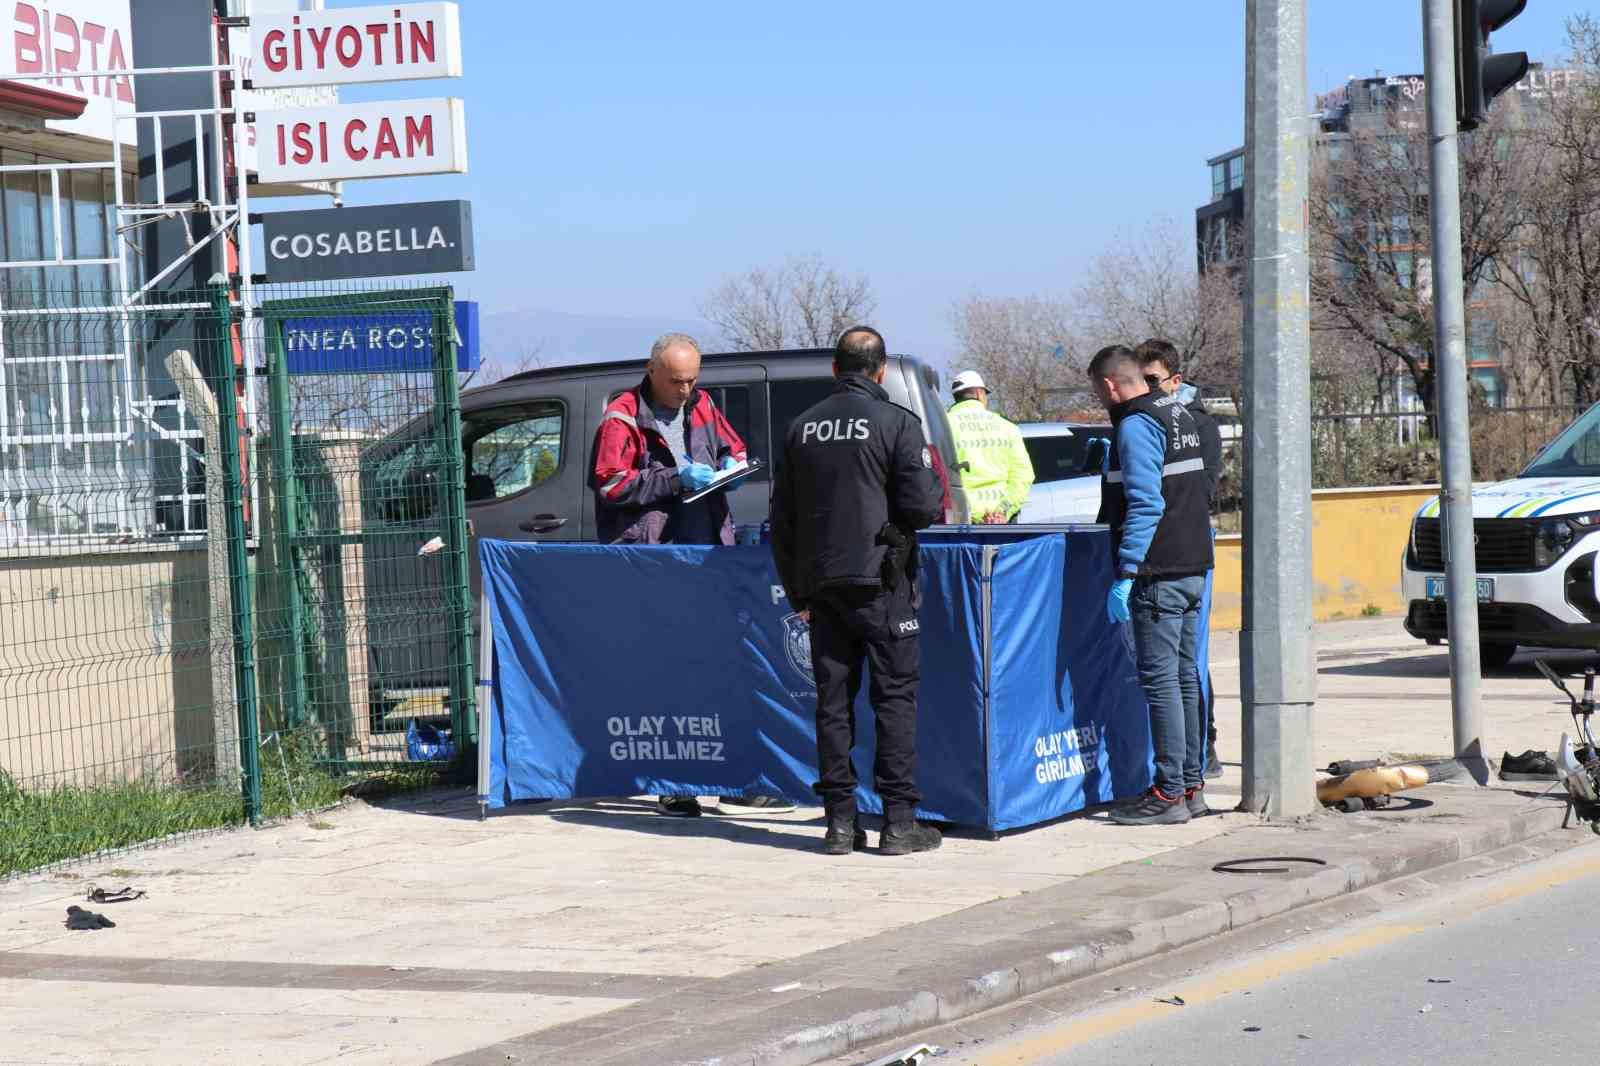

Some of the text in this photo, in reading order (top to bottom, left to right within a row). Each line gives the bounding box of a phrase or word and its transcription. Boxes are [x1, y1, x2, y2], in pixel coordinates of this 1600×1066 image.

[263, 10, 435, 72] GİYOTİN
[277, 121, 328, 165] ISI
[343, 114, 434, 161] CAM
[270, 226, 455, 260] COSABELLA.
[288, 328, 357, 351] INEA
[607, 713, 722, 737] OLAY YERİ
[609, 736, 726, 761] GİRİLMEZ
[1035, 732, 1061, 758] OLAY
